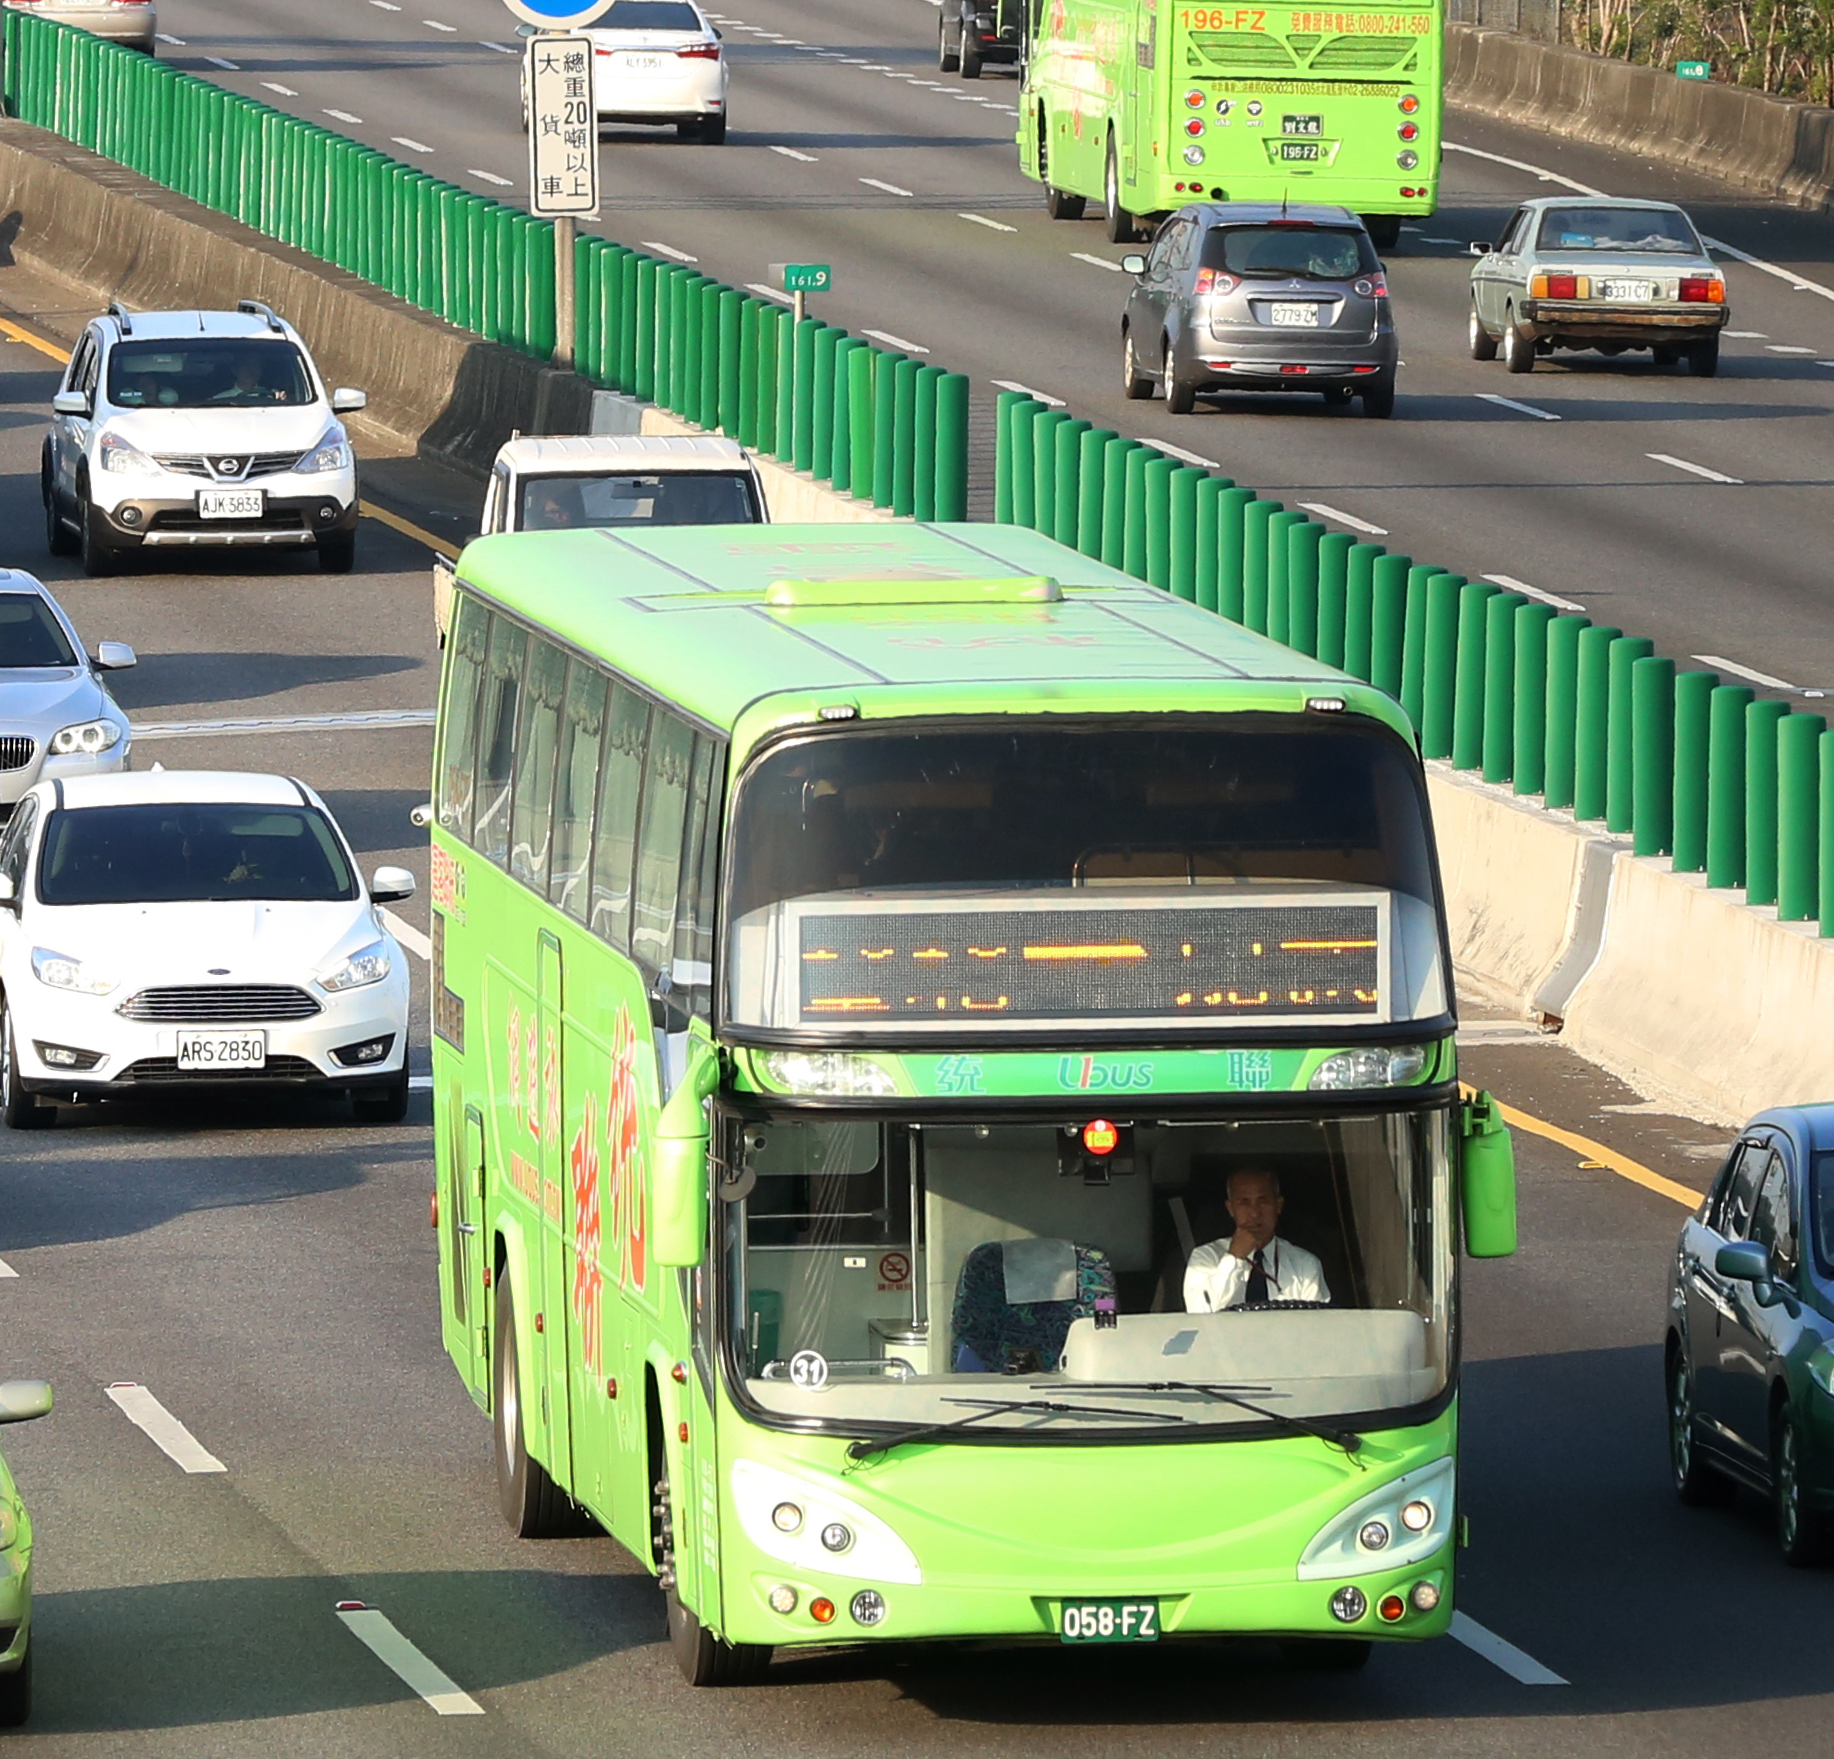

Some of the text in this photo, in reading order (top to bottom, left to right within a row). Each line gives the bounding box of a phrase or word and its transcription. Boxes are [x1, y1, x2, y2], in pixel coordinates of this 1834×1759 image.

[1180, 9, 1267, 31] 196-FZ
[538, 52, 564, 198] 大貨車
[1283, 145, 1317, 159] 196-FZ
[791, 271, 827, 286] 161.9
[935, 1055, 986, 1094] 統
[1226, 1049, 1273, 1091] 聯
[796, 1358, 821, 1383] 31
[1064, 1605, 1156, 1637] 058-FZ
